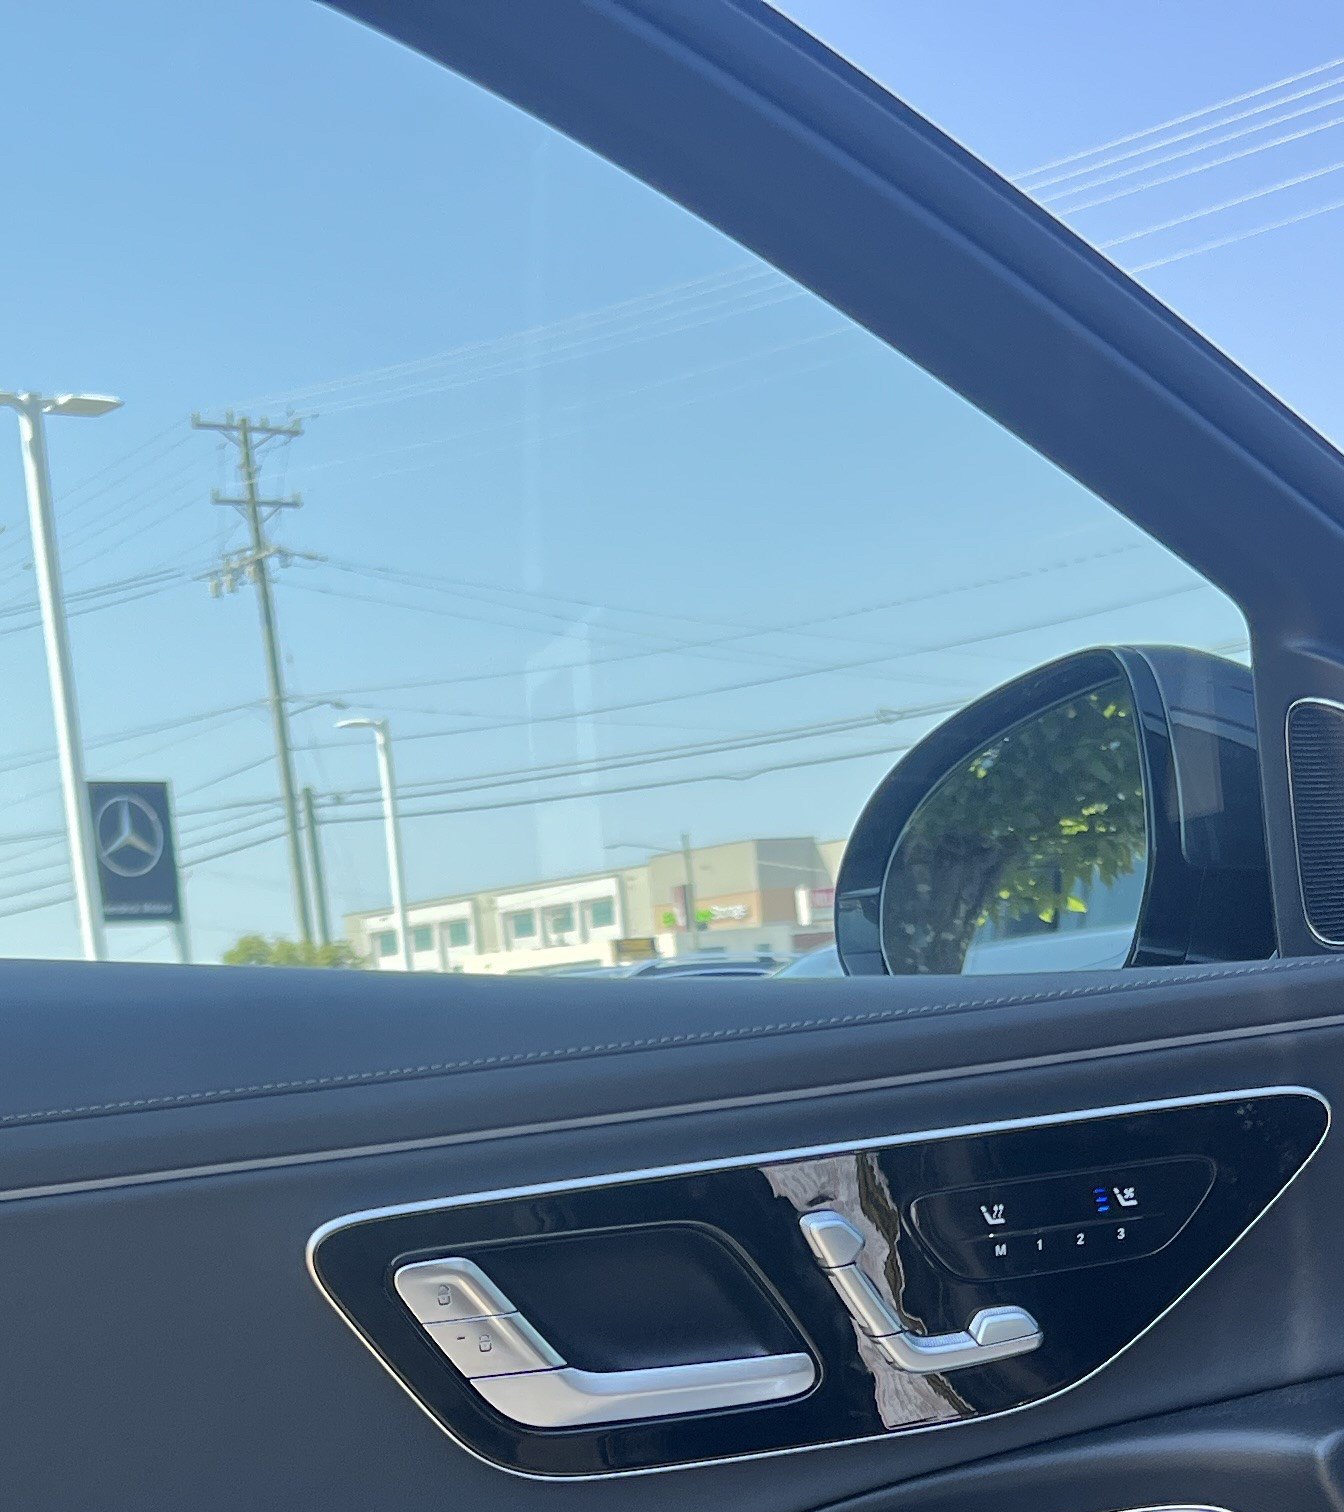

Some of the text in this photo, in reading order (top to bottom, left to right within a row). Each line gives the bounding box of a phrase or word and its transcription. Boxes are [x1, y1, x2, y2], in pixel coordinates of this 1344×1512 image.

[995, 1228, 1125, 1256] M 1 2 3
